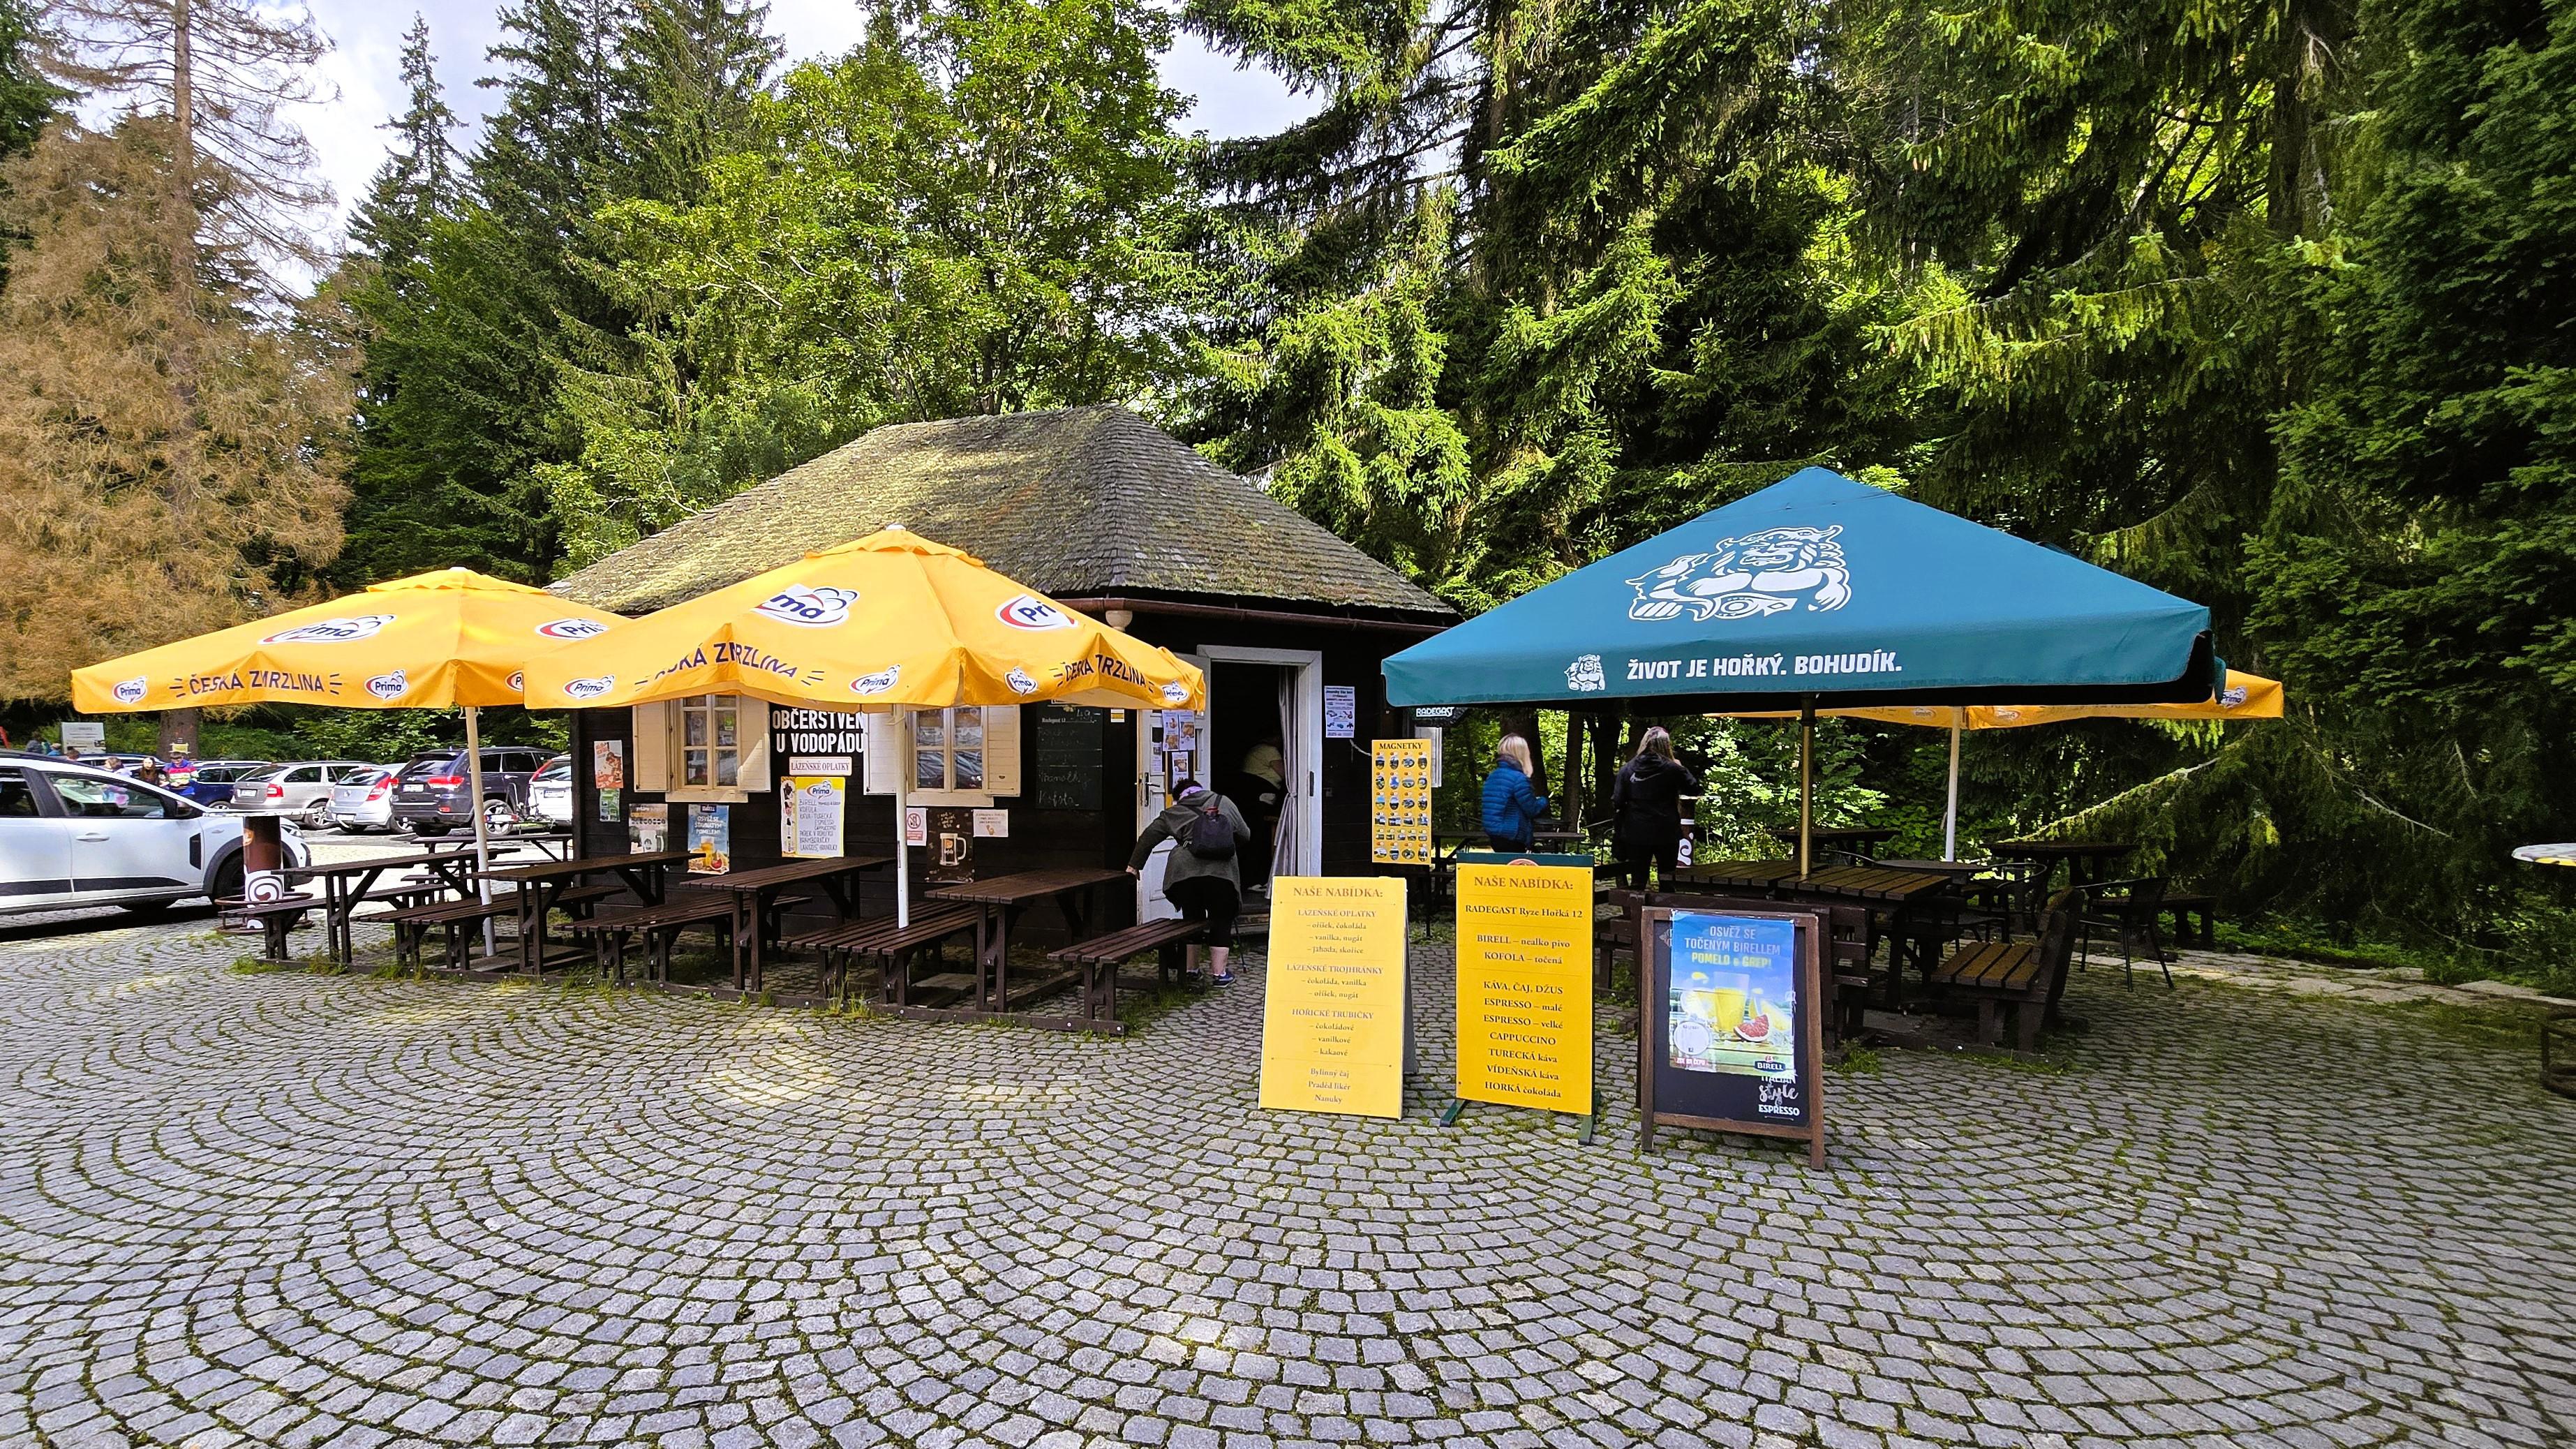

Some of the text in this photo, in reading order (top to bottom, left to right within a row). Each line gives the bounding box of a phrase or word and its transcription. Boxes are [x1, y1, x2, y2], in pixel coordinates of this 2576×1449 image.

[1018, 601, 1057, 621] Pri
[1627, 648, 1903, 680] ŽIVOT JE HOŘKÝ. BOHUDÍK.
[189, 668, 245, 694] ČESKÁ
[375, 681, 402, 692] Prima
[861, 676, 890, 688] Prima
[120, 687, 142, 696] Prima
[574, 683, 603, 692] Prima
[1415, 706, 1455, 718] RADEGAST
[772, 708, 863, 729] OBČERSTVEN
[776, 731, 864, 753] U VODOPÁDU
[791, 760, 850, 771] LÁZEŇSKÉ OPLATKY
[1474, 875, 1574, 890] NAŠE NABÍDKA:
[1293, 886, 1383, 898] NAŠE NABÍDKA:
[1298, 908, 1377, 918] LÁZEŇSKÉ OPLATKY
[1465, 905, 1517, 915] RADEGAST
[1519, 907, 1540, 917] Ryze
[1542, 908, 1570, 918] Hořká
[1710, 925, 1756, 939] OSVĚŽ SE
[1343, 935, 1362, 943] nugát
[1477, 935, 1570, 949] BIRELL nealko pivo
[1313, 946, 1364, 954] jahoda, skořice
[1684, 937, 1780, 956] TOČENÝM BIRELLEM
[1484, 951, 1563, 965] KOFOLA točená
[1692, 952, 1730, 965] POMELO
[1742, 956, 1772, 968] GREP!
[1287, 963, 1383, 975] LÁZEŇSKÉ TROJHRÁNKY
[1307, 977, 1340, 986] čokoláda,
[1484, 981, 1563, 995] KÁVA, ČAJ, DŽUS
[1314, 990, 1358, 1000] oříšek, nugát
[1484, 998, 1563, 1012] ESPRESSO malé
[1292, 1008, 1374, 1019] HOŘICKÉ TRUBIČKY
[1316, 1023, 1354, 1031] čokoládové
[1484, 1014, 1563, 1030] ESPRESSO velké
[1489, 1032, 1556, 1046] CAPPUCCINO
[1489, 1048, 1558, 1063] TURECKÁ káva
[1487, 1064, 1559, 1080] VÍDEŇSKÁ káva
[1757, 1062, 1784, 1071] BIRELL
[1311, 1068, 1349, 1078] Bylinný čaj
[1309, 1080, 1350, 1090] Praděd likér
[1484, 1081, 1561, 1098] HORKÁ čokoláda
[1315, 1094, 1343, 1104] Nanuky
[1759, 1083, 1799, 1106] style
[1758, 1104, 1801, 1116] ESPRESSO
